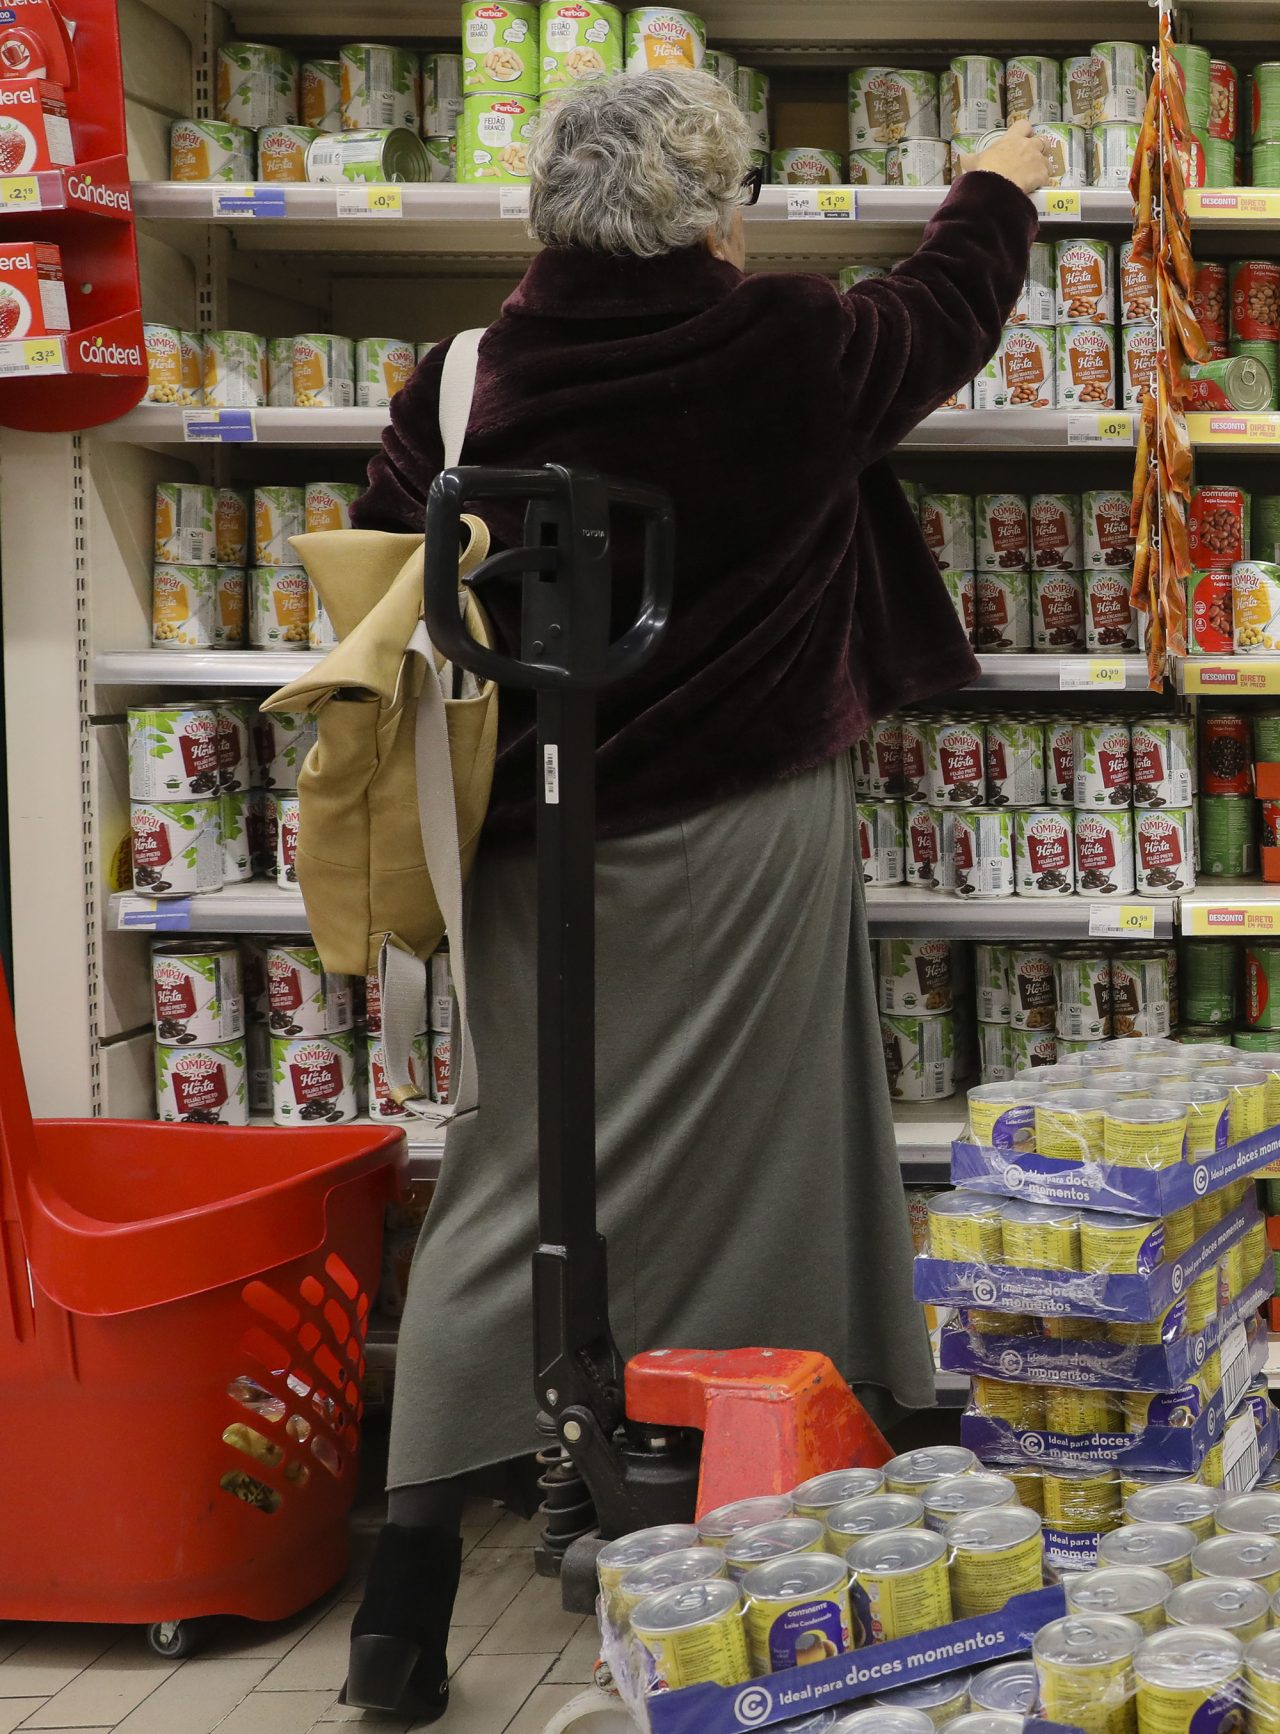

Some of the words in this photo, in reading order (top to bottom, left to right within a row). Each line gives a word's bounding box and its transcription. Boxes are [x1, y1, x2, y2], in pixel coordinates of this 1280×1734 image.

[477, 9, 505, 18] Ferbar
[559, 9, 588, 18] Ferbar
[494, 104, 522, 114] Ferbar
[68, 176, 131, 211] Canderel
[80, 341, 142, 365] Canderel
[1104, 424, 1126, 436] €0,99
[1096, 668, 1118, 680] €0,99
[1201, 673, 1236, 682] DESCONTO
[1126, 915, 1148, 928] €0,99
[1209, 914, 1244, 922] DESCONTO
[1236, 1146, 1258, 1167] doces
[1048, 1436, 1068, 1446] Ideal
[1070, 1439, 1090, 1448] para
[1091, 1434, 1130, 1446] doces
[1050, 1448, 1118, 1460] momentos
[1050, 1534, 1068, 1546] Ideal
[1070, 1538, 1090, 1547] para
[779, 1686, 812, 1706] Ideal
[814, 1680, 843, 1700] para
[844, 1657, 902, 1688] doces
[906, 1628, 1006, 1665] momentos
